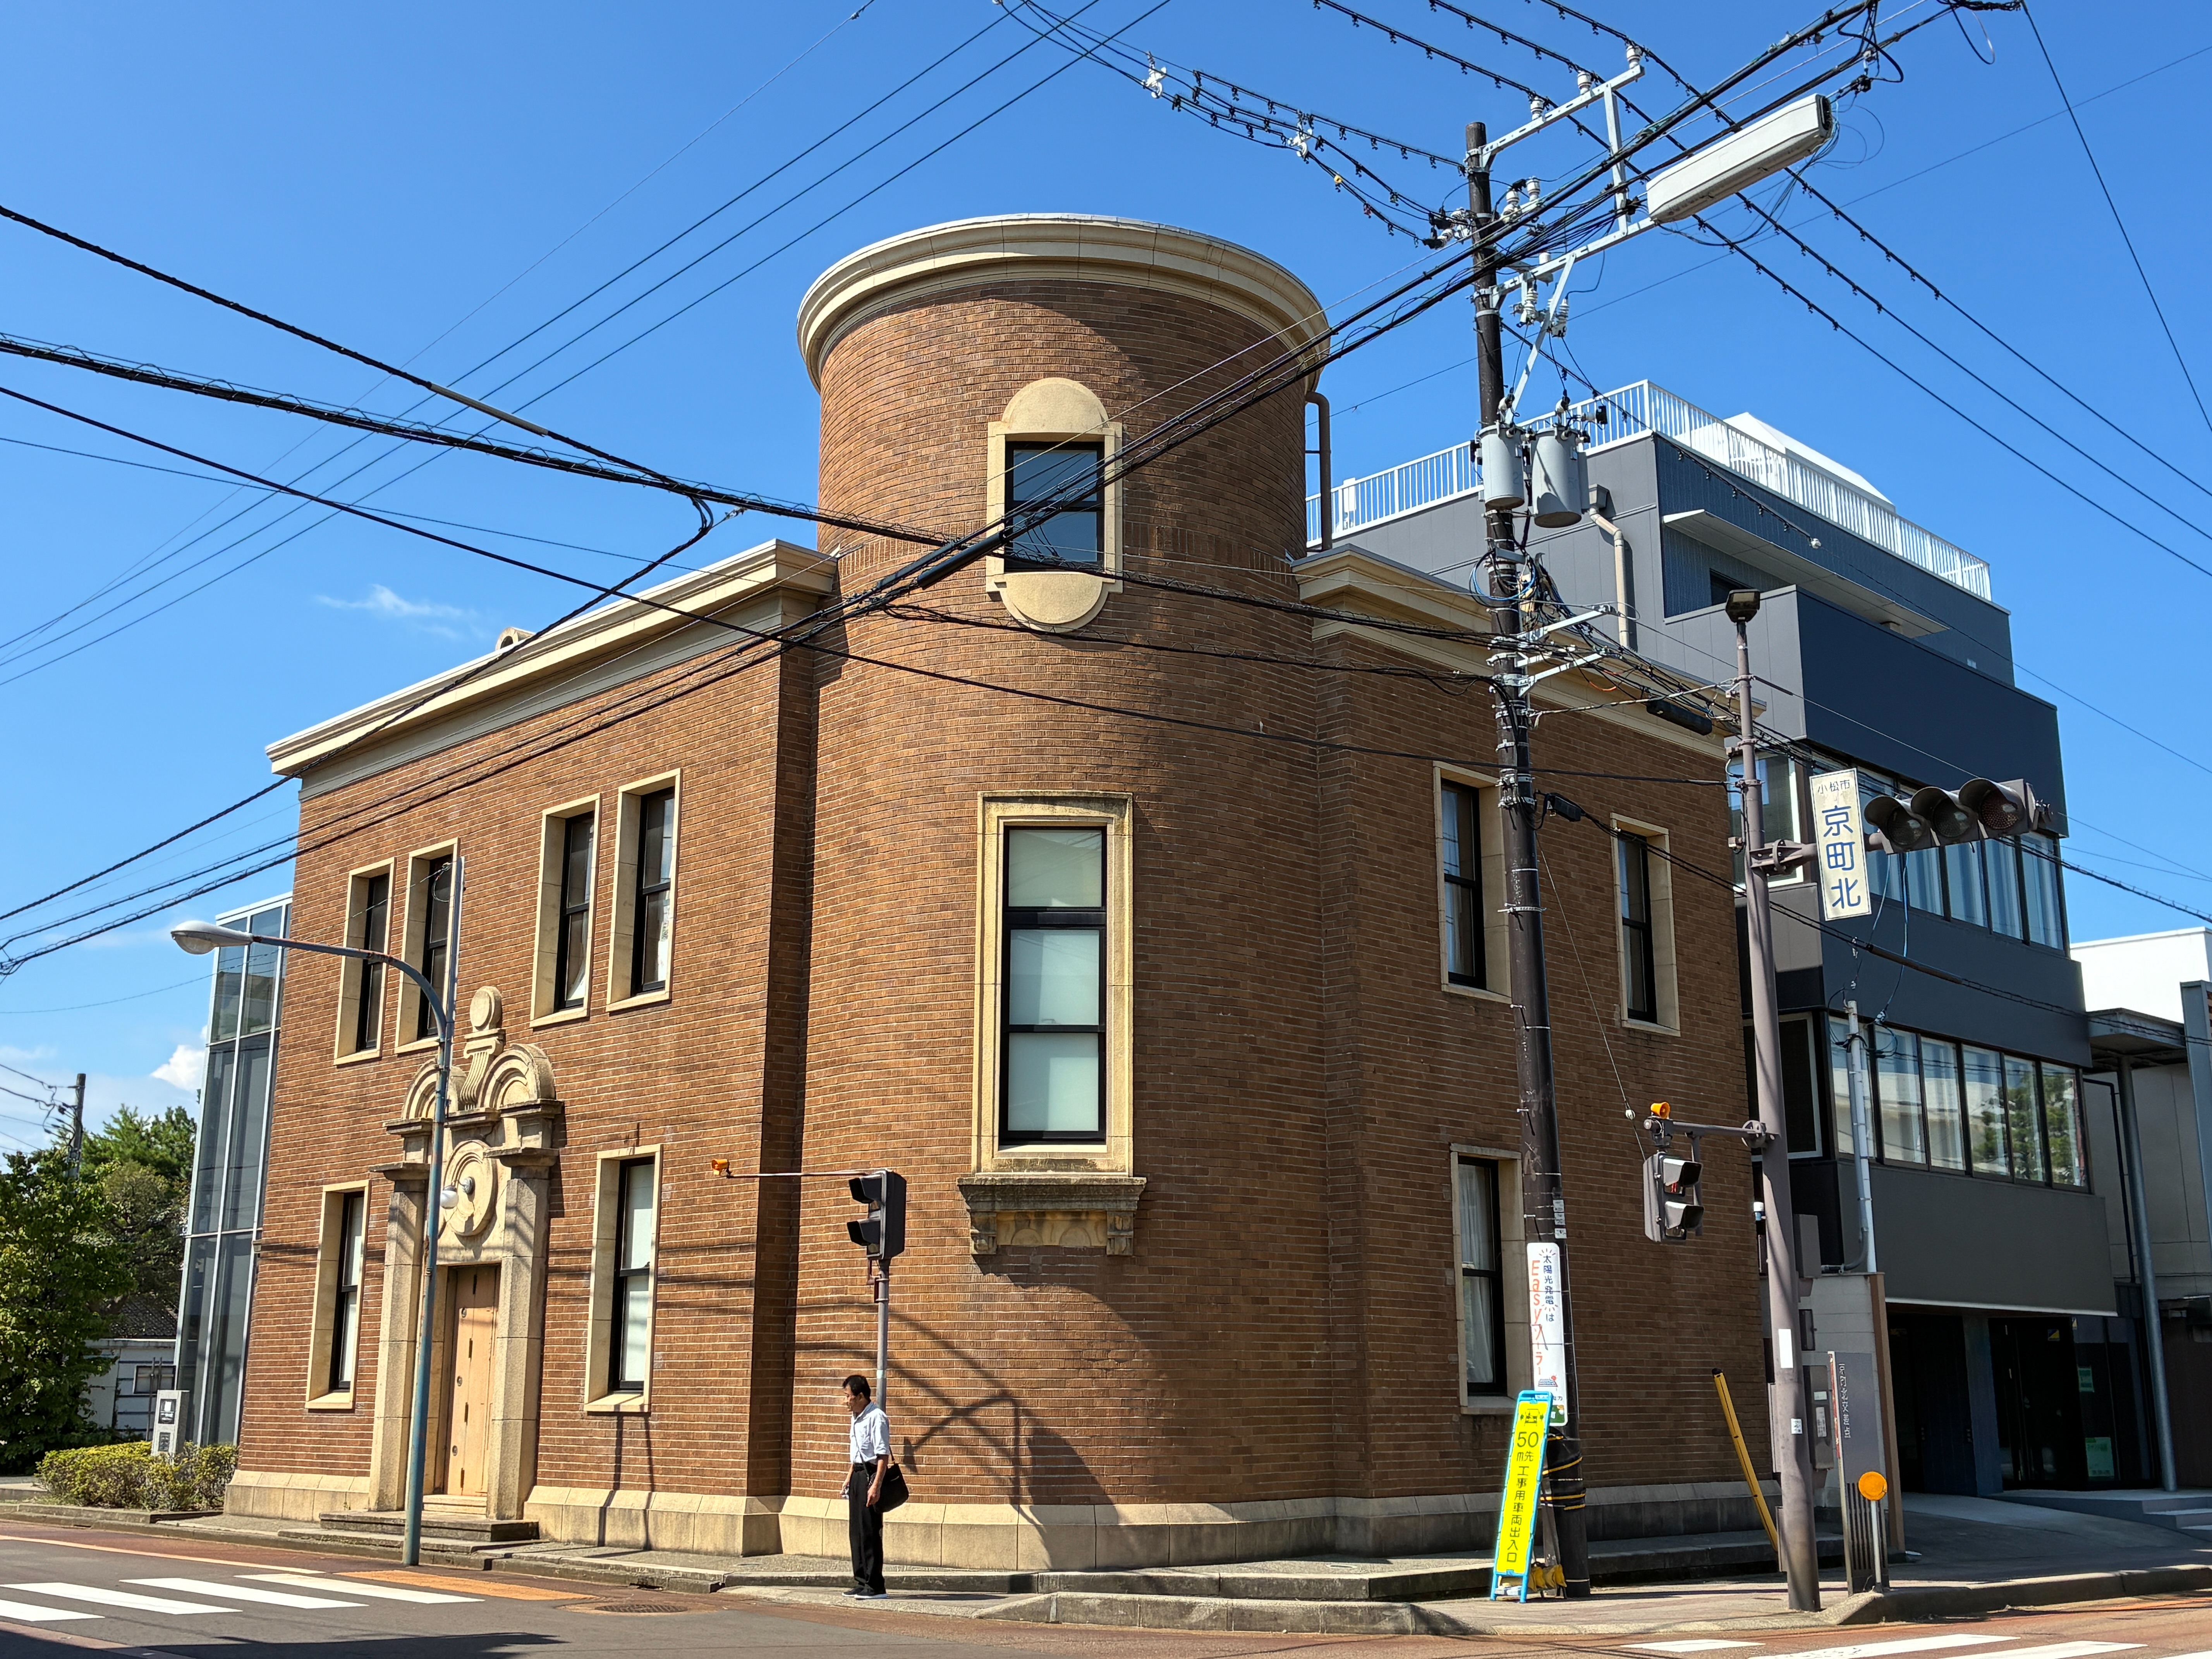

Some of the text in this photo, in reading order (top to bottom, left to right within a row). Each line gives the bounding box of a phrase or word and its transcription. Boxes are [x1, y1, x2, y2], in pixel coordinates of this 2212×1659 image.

[1818, 780, 1850, 794] 小松市
[1822, 805, 1861, 909] 京町北
[1517, 1432, 1539, 1448] 50
[1506, 1466, 1529, 1563] 工事用車両出入口
